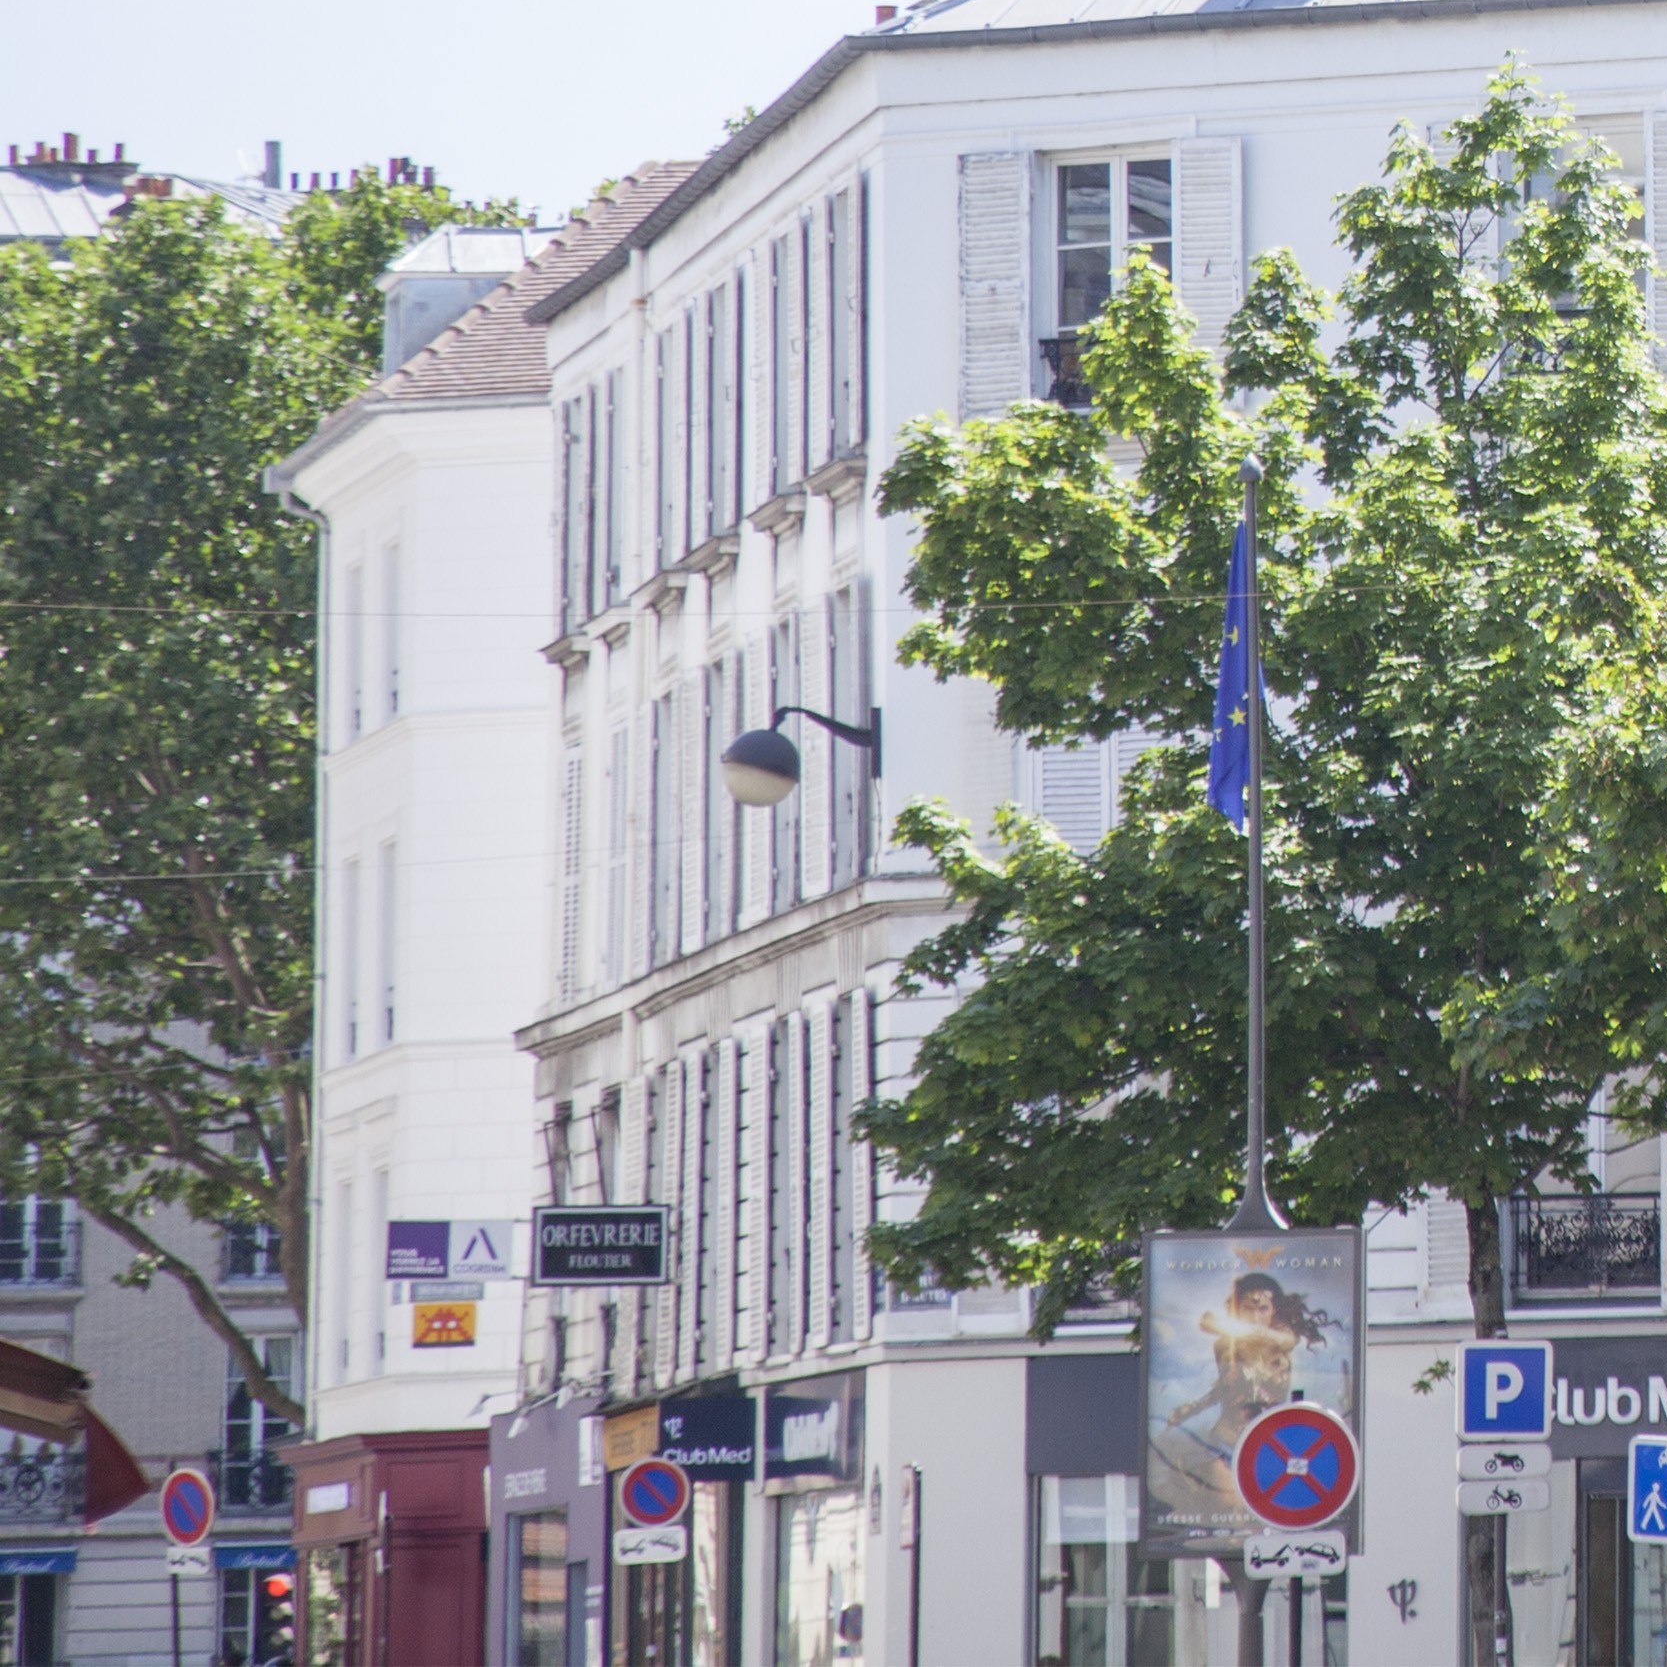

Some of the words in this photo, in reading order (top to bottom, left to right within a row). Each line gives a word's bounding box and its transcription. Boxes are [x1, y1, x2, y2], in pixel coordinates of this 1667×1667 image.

[542, 1223, 661, 1248] ORFEVRERIE
[1166, 1259, 1242, 1271] WONDER
[1275, 1256, 1343, 1269] WOMAN
[1485, 1362, 1523, 1421] P
[1551, 1375, 1642, 1426] lub
[662, 1447, 711, 1466] Club
[711, 1446, 752, 1465] Med
